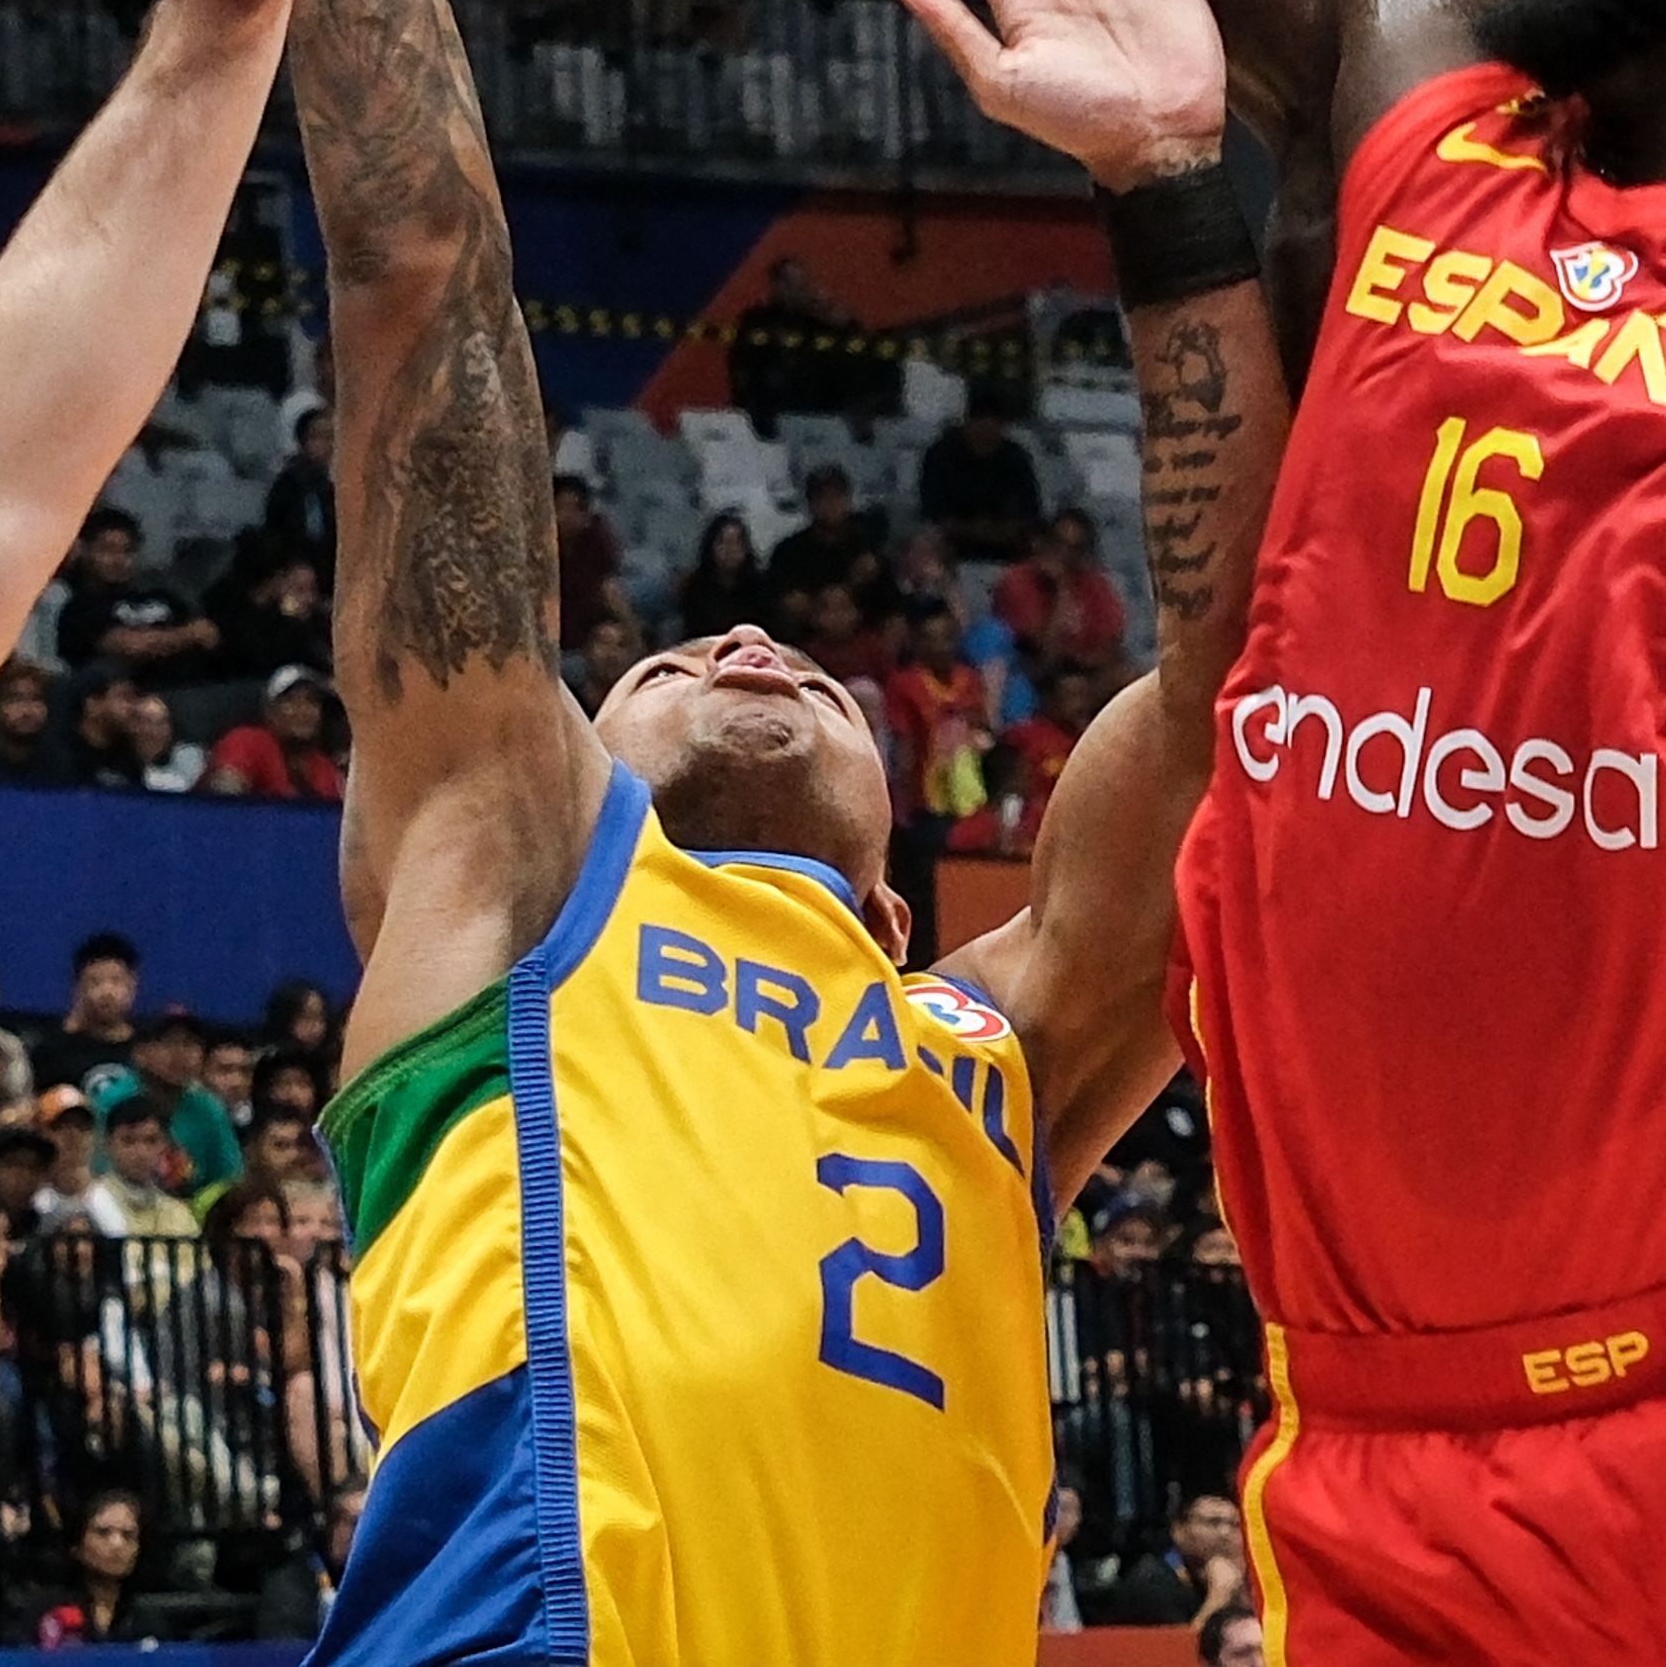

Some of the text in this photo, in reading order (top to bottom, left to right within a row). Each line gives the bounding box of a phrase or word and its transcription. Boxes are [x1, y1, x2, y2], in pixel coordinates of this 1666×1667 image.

[1407, 416, 1545, 608] 16
[1232, 683, 1659, 852] endesa
[815, 1151, 947, 1413] 2
[1521, 1330, 1650, 1395] ESP
